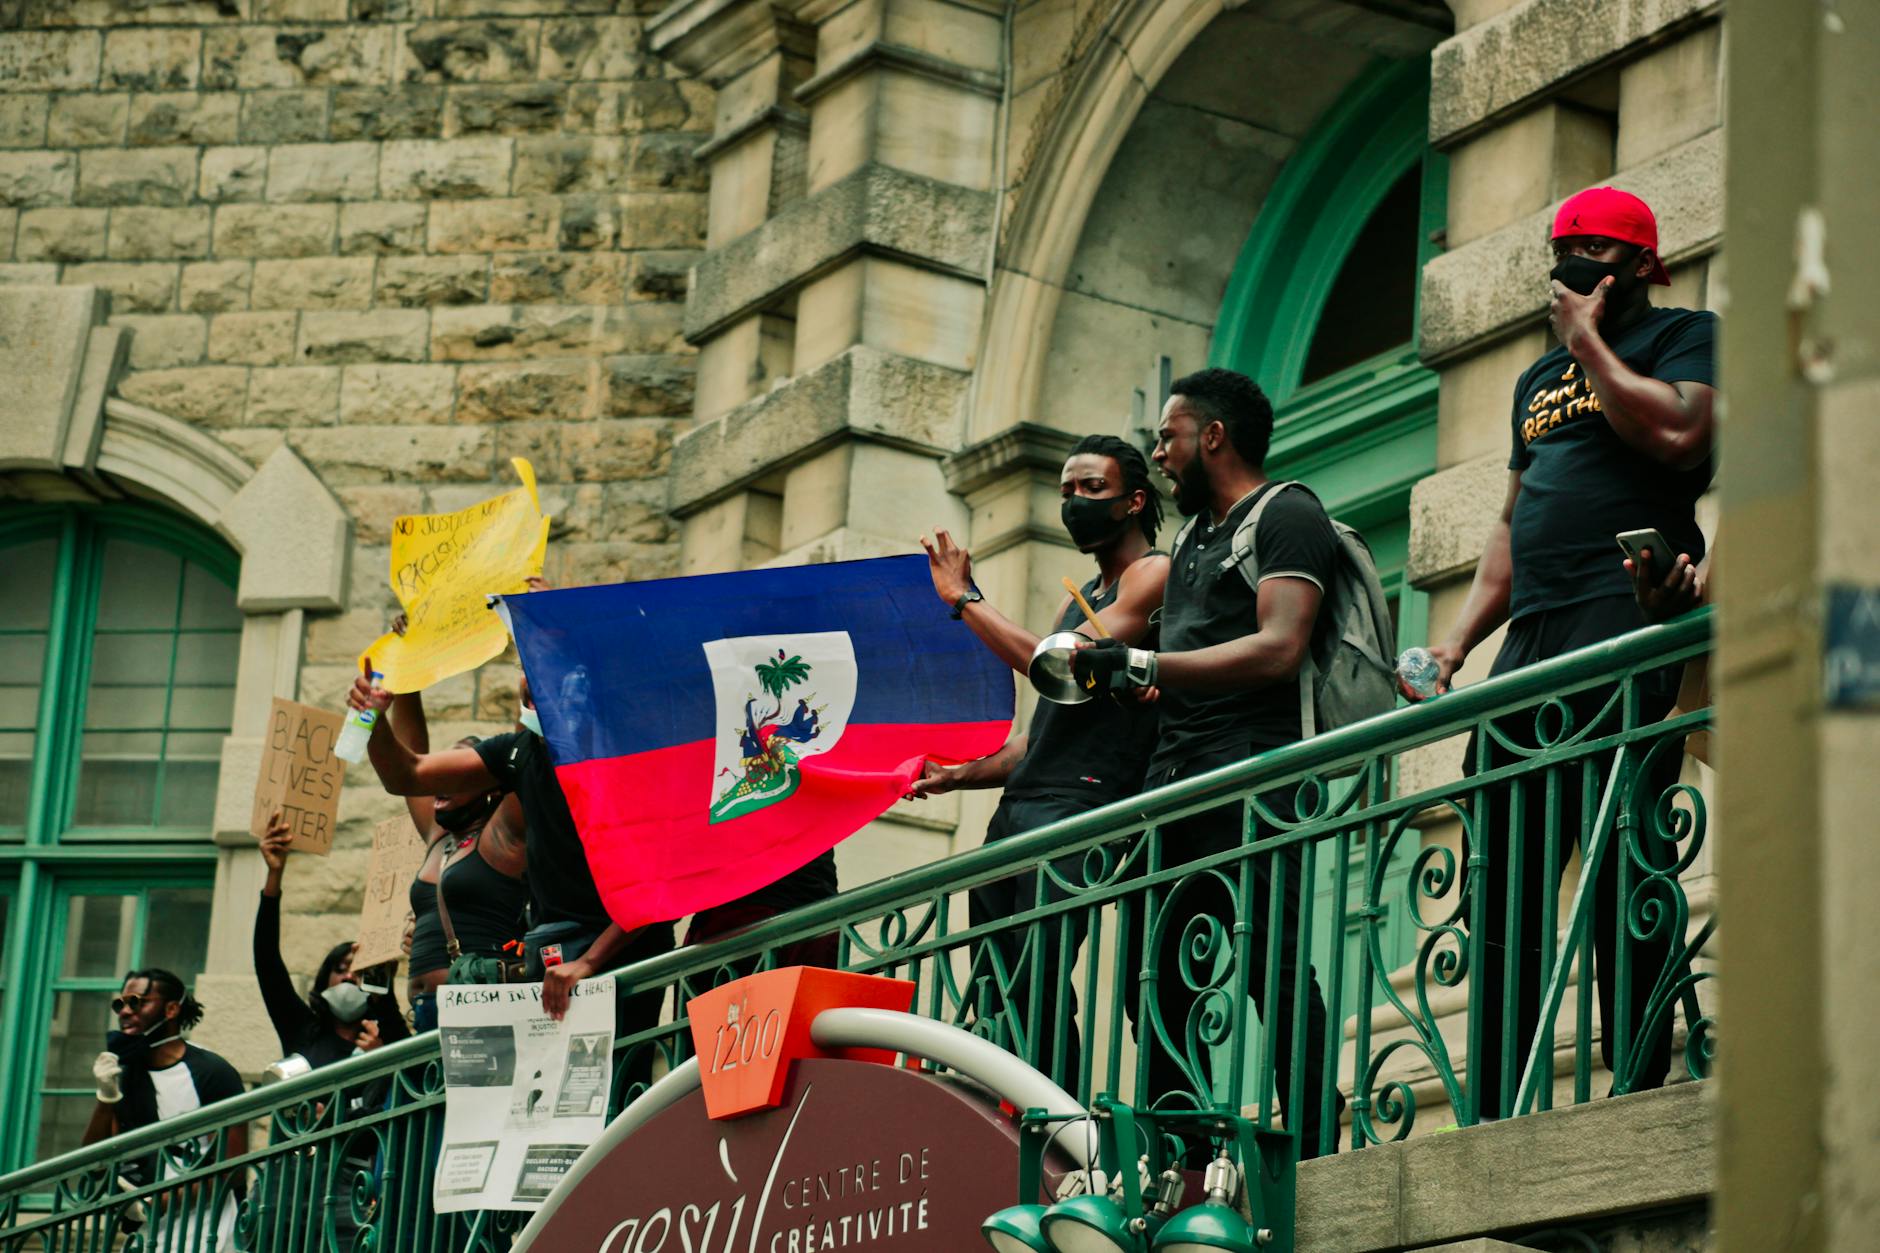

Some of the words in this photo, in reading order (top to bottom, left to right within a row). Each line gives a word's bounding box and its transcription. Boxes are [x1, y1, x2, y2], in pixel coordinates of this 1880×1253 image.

[1561, 363, 1576, 381] I
[395, 516, 415, 537] NO
[420, 507, 474, 536] JUSTICE
[271, 709, 341, 773] BLACK
[267, 756, 334, 801] LIVES
[445, 990, 500, 1008] RACISM
[509, 992, 527, 1002] IN
[710, 1008, 782, 1075] 1200
[782, 1160, 880, 1211] CENTRE
[899, 1148, 929, 1185] DE
[770, 1188, 929, 1253] CRÉATIVITÉ
